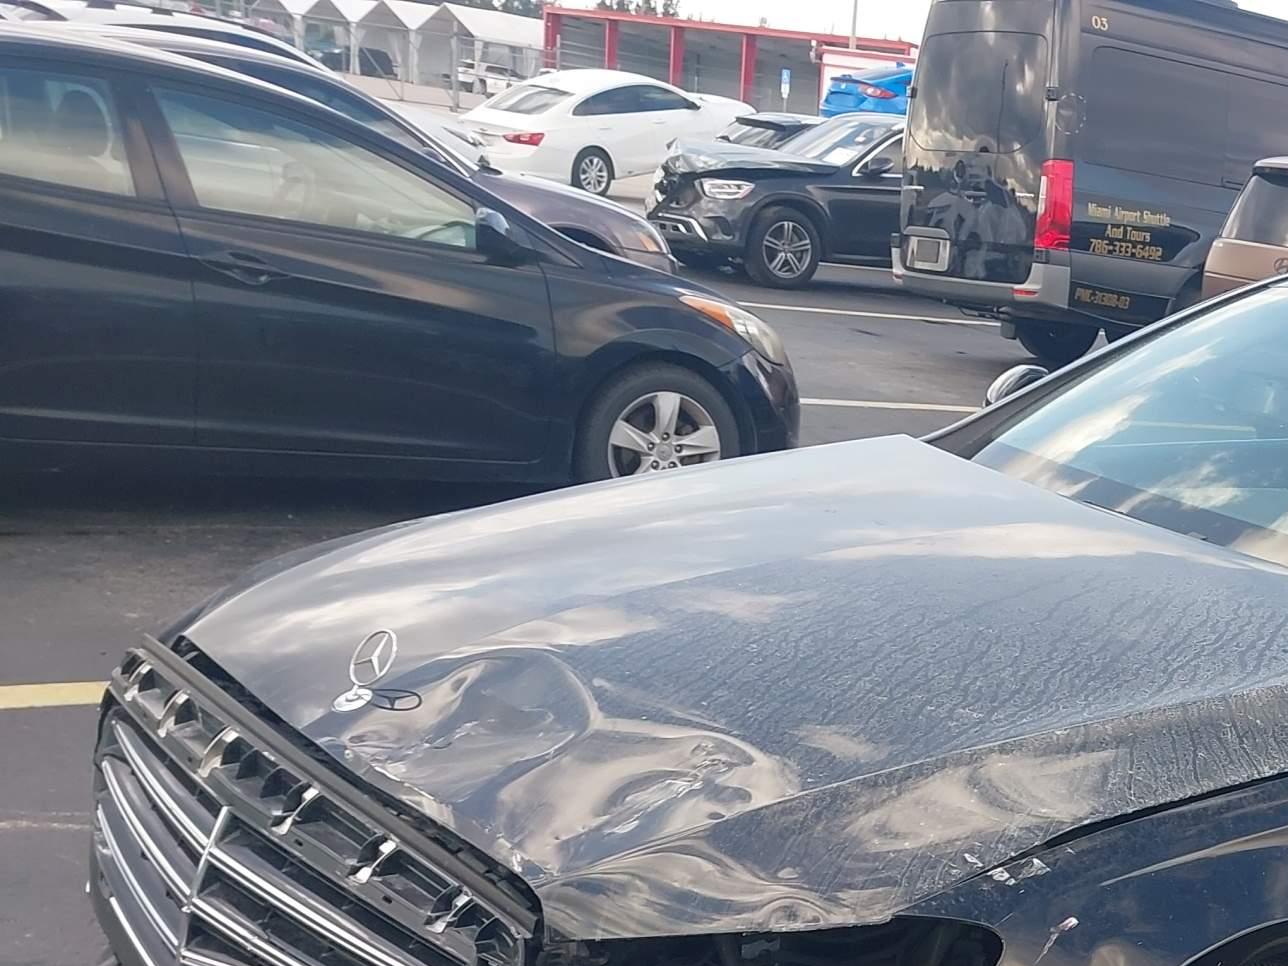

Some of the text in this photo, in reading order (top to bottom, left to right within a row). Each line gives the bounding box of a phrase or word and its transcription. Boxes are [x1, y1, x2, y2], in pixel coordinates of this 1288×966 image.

[1092, 15, 1109, 31] 03
[1088, 202, 1171, 227] Miami Airport Shuttle
[1105, 224, 1151, 242] And Tours
[1089, 239, 1163, 260] 786-333-6492
